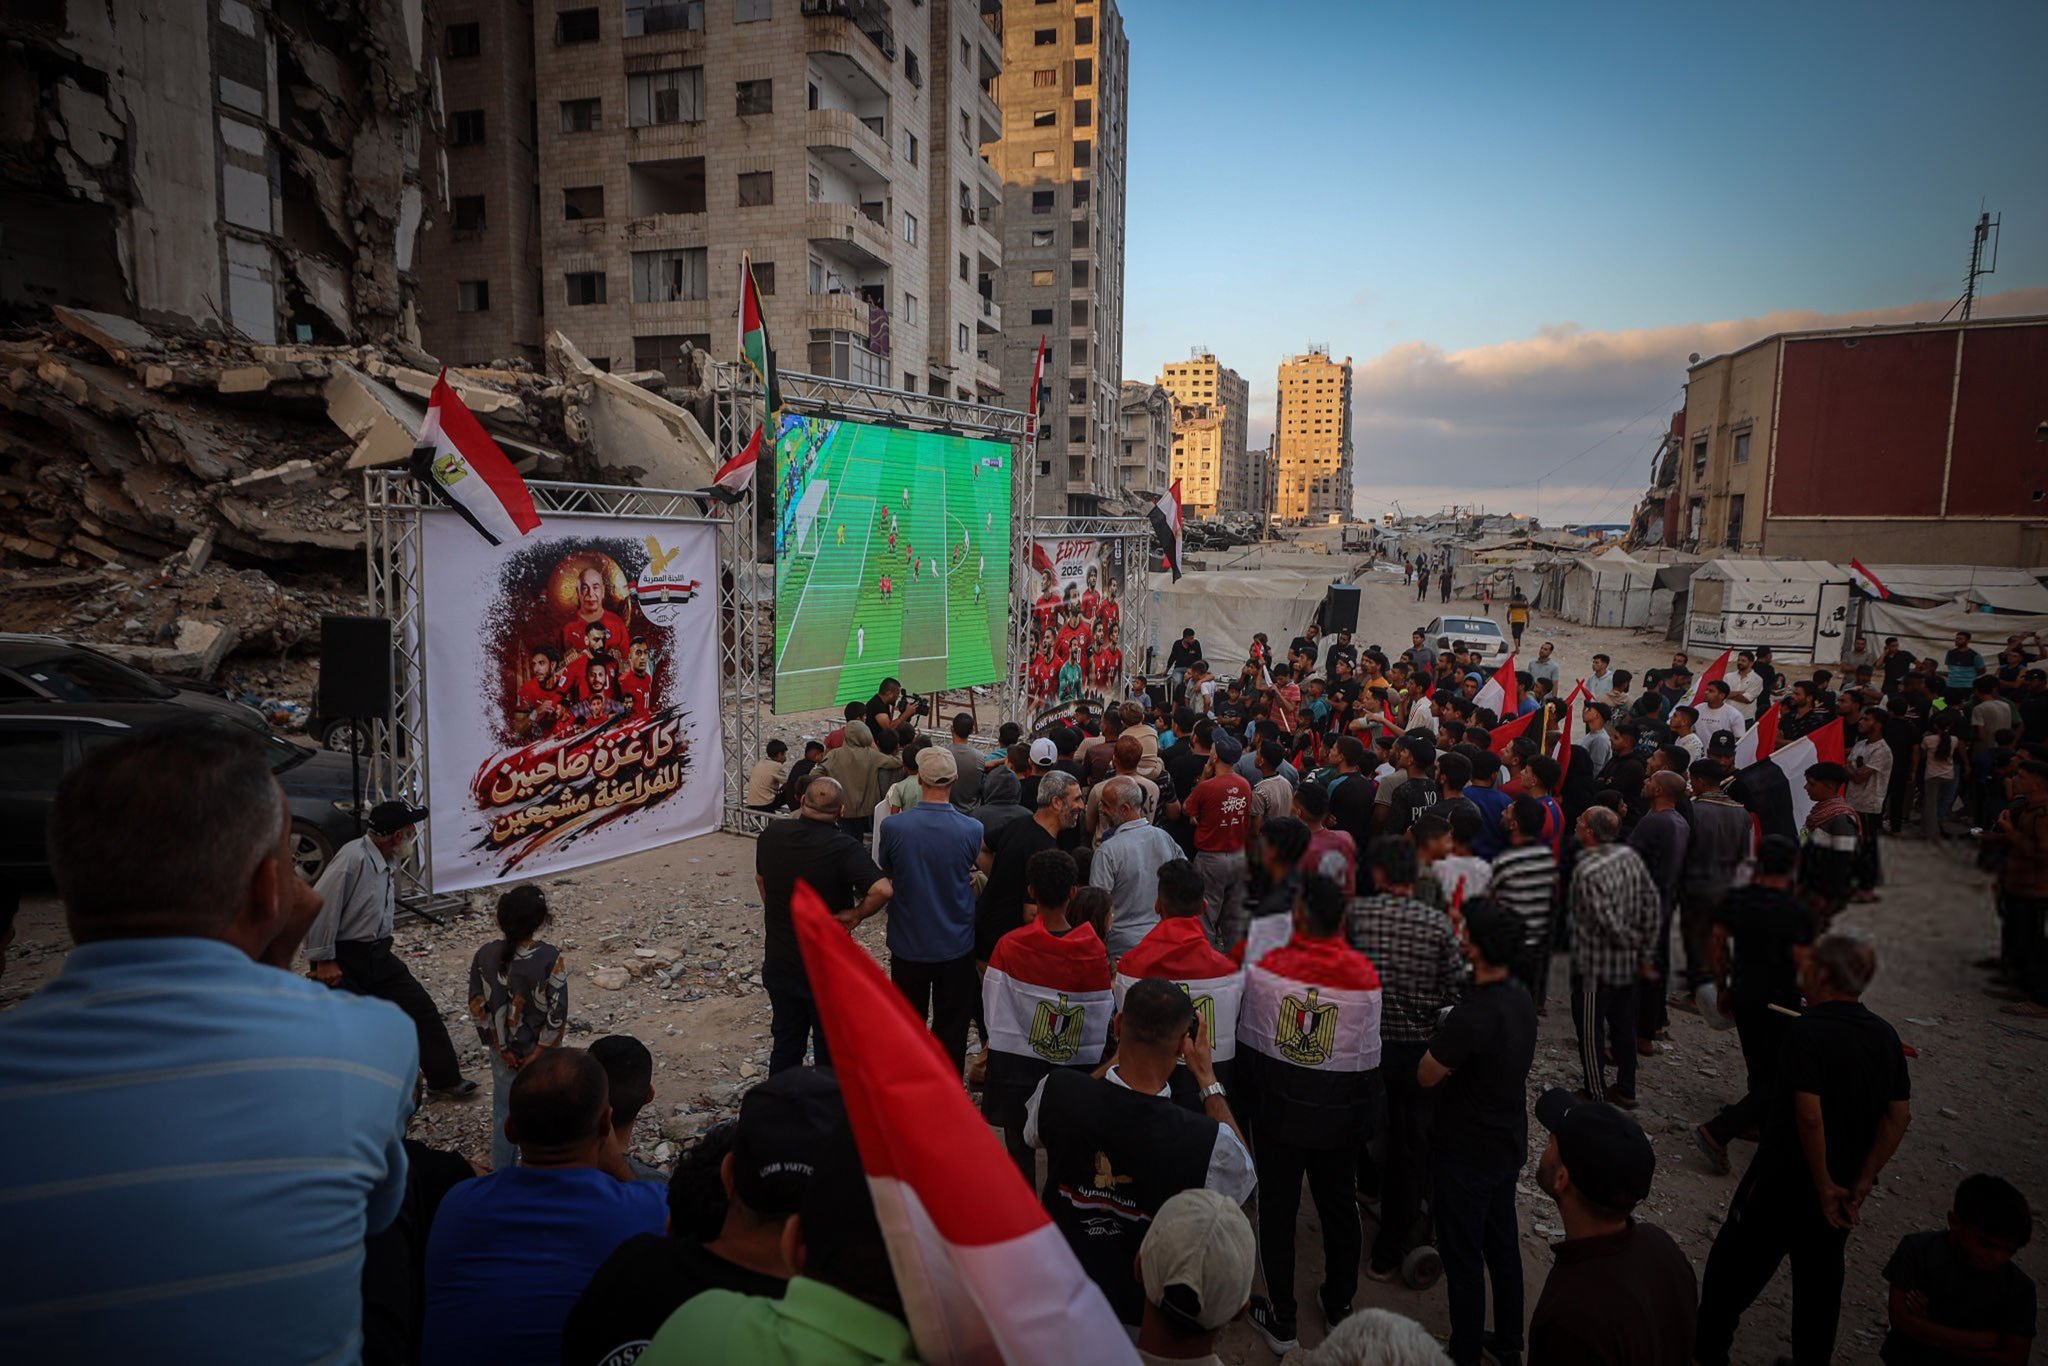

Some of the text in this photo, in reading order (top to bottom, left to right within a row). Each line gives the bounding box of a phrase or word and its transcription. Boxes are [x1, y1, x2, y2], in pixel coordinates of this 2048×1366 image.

[1055, 539, 1096, 565] EGYPT
[1061, 565, 1084, 576] 2026
[643, 574, 667, 584] المصرية
[594, 730, 643, 778] غزة
[643, 717, 680, 768] كل
[491, 762, 680, 842] للفراعنة مشجعين
